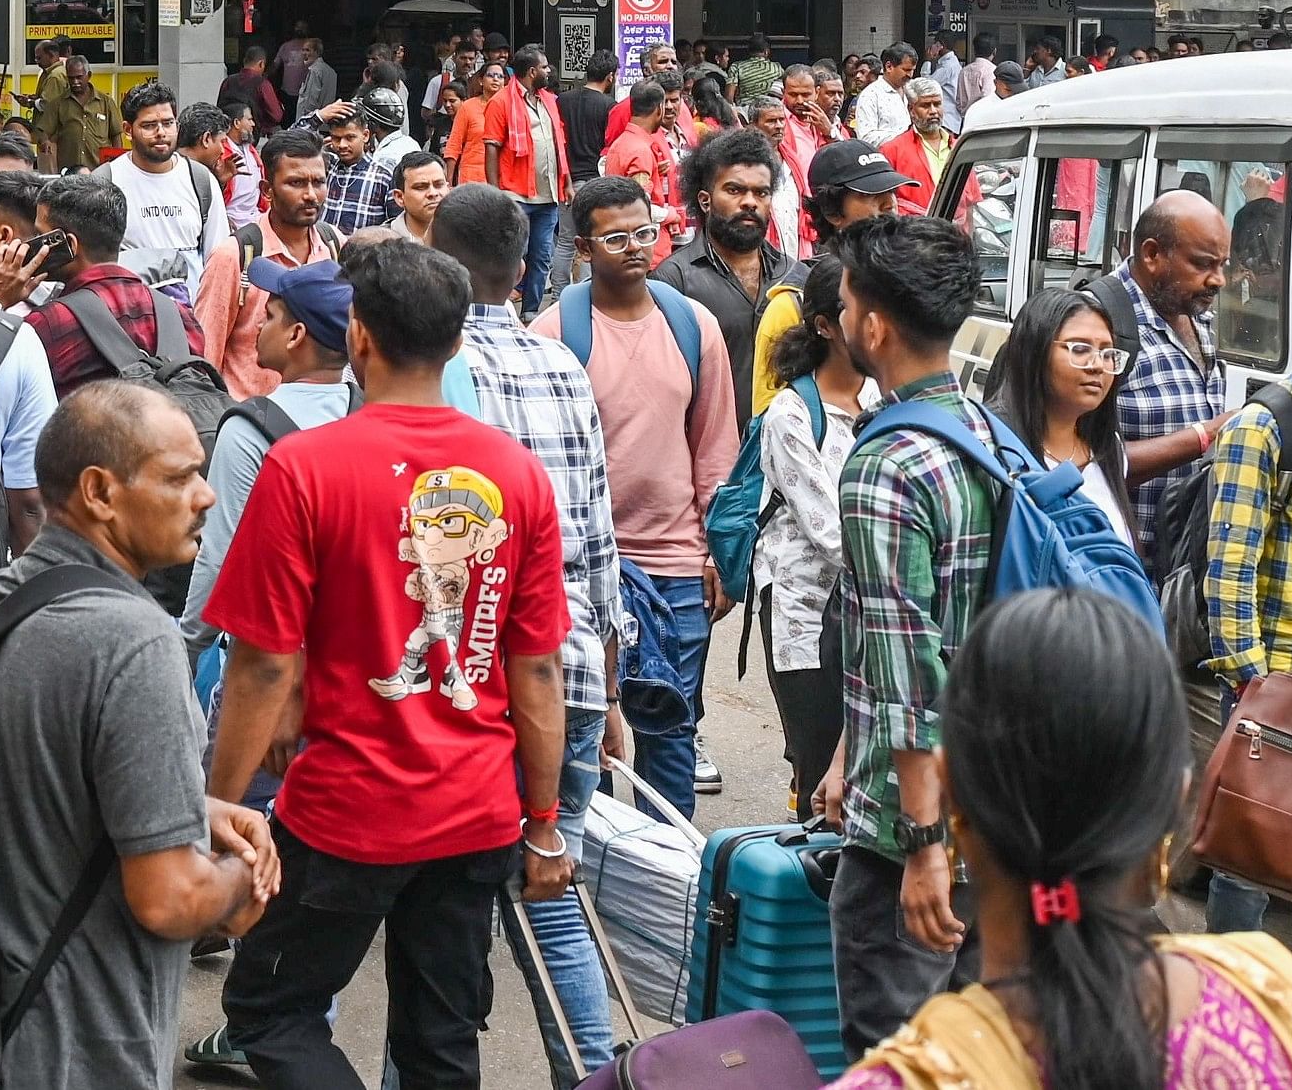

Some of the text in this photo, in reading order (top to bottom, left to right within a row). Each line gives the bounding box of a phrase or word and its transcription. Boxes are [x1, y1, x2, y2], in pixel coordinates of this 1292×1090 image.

[621, 14, 668, 22] NO PARKING
[29, 25, 113, 36] PRINT OUT AVAILABLE
[141, 206, 182, 218] UNTD YOUTH
[434, 475, 443, 486] S
[465, 566, 507, 684] SMURFS
